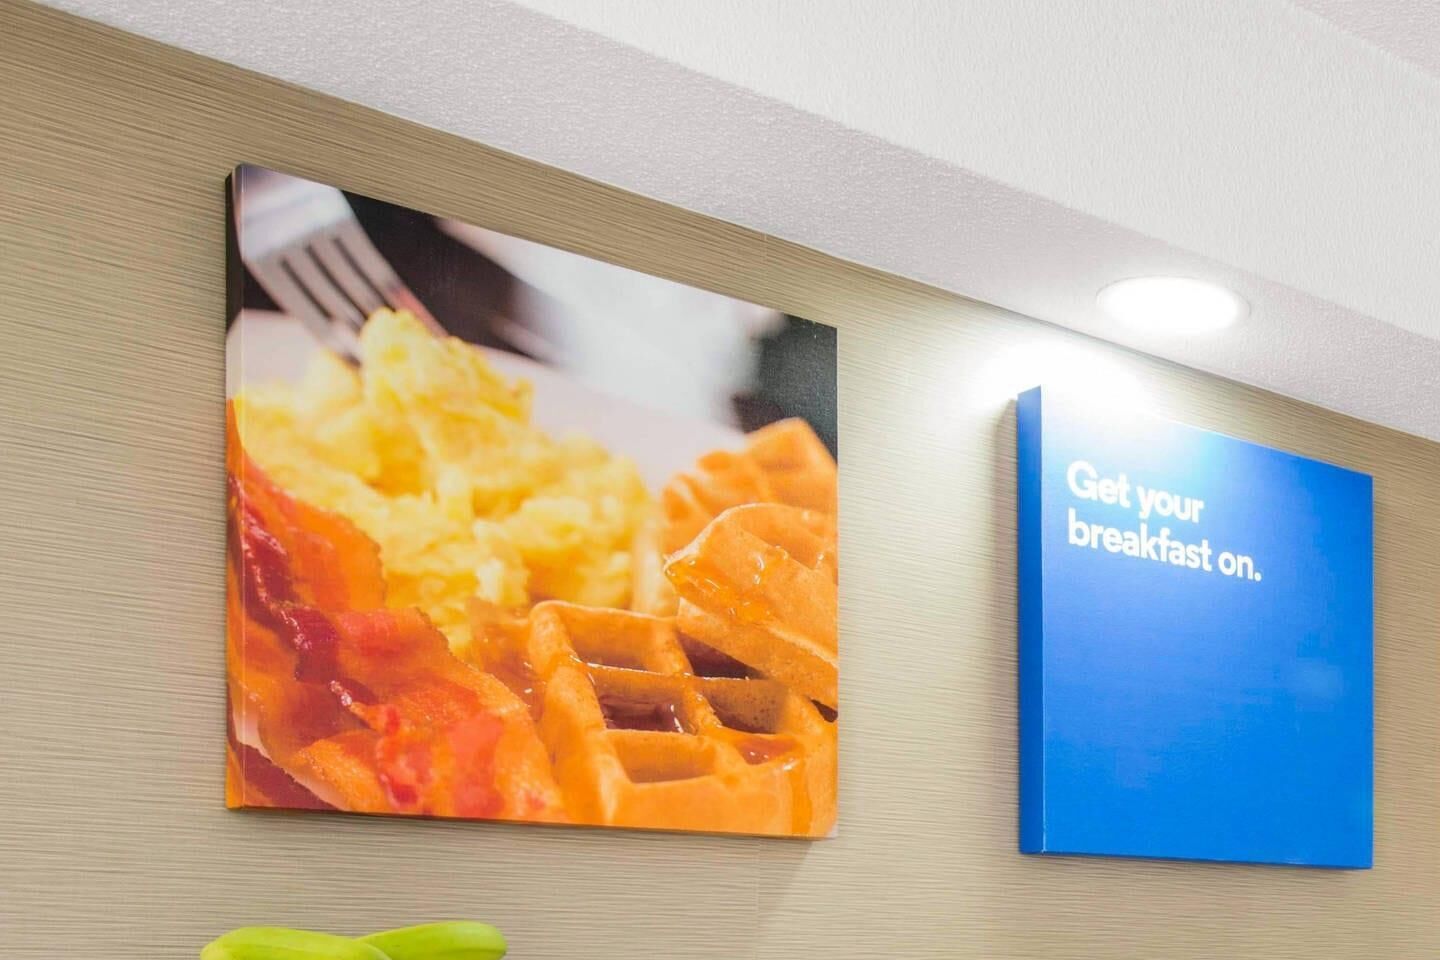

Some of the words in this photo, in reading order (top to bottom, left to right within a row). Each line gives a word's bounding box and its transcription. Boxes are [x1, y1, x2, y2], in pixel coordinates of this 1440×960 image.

[1066, 459, 1131, 509] Get
[1136, 484, 1205, 523] your
[1067, 508, 1212, 572] breakfast
[1218, 550, 1263, 582] on.
